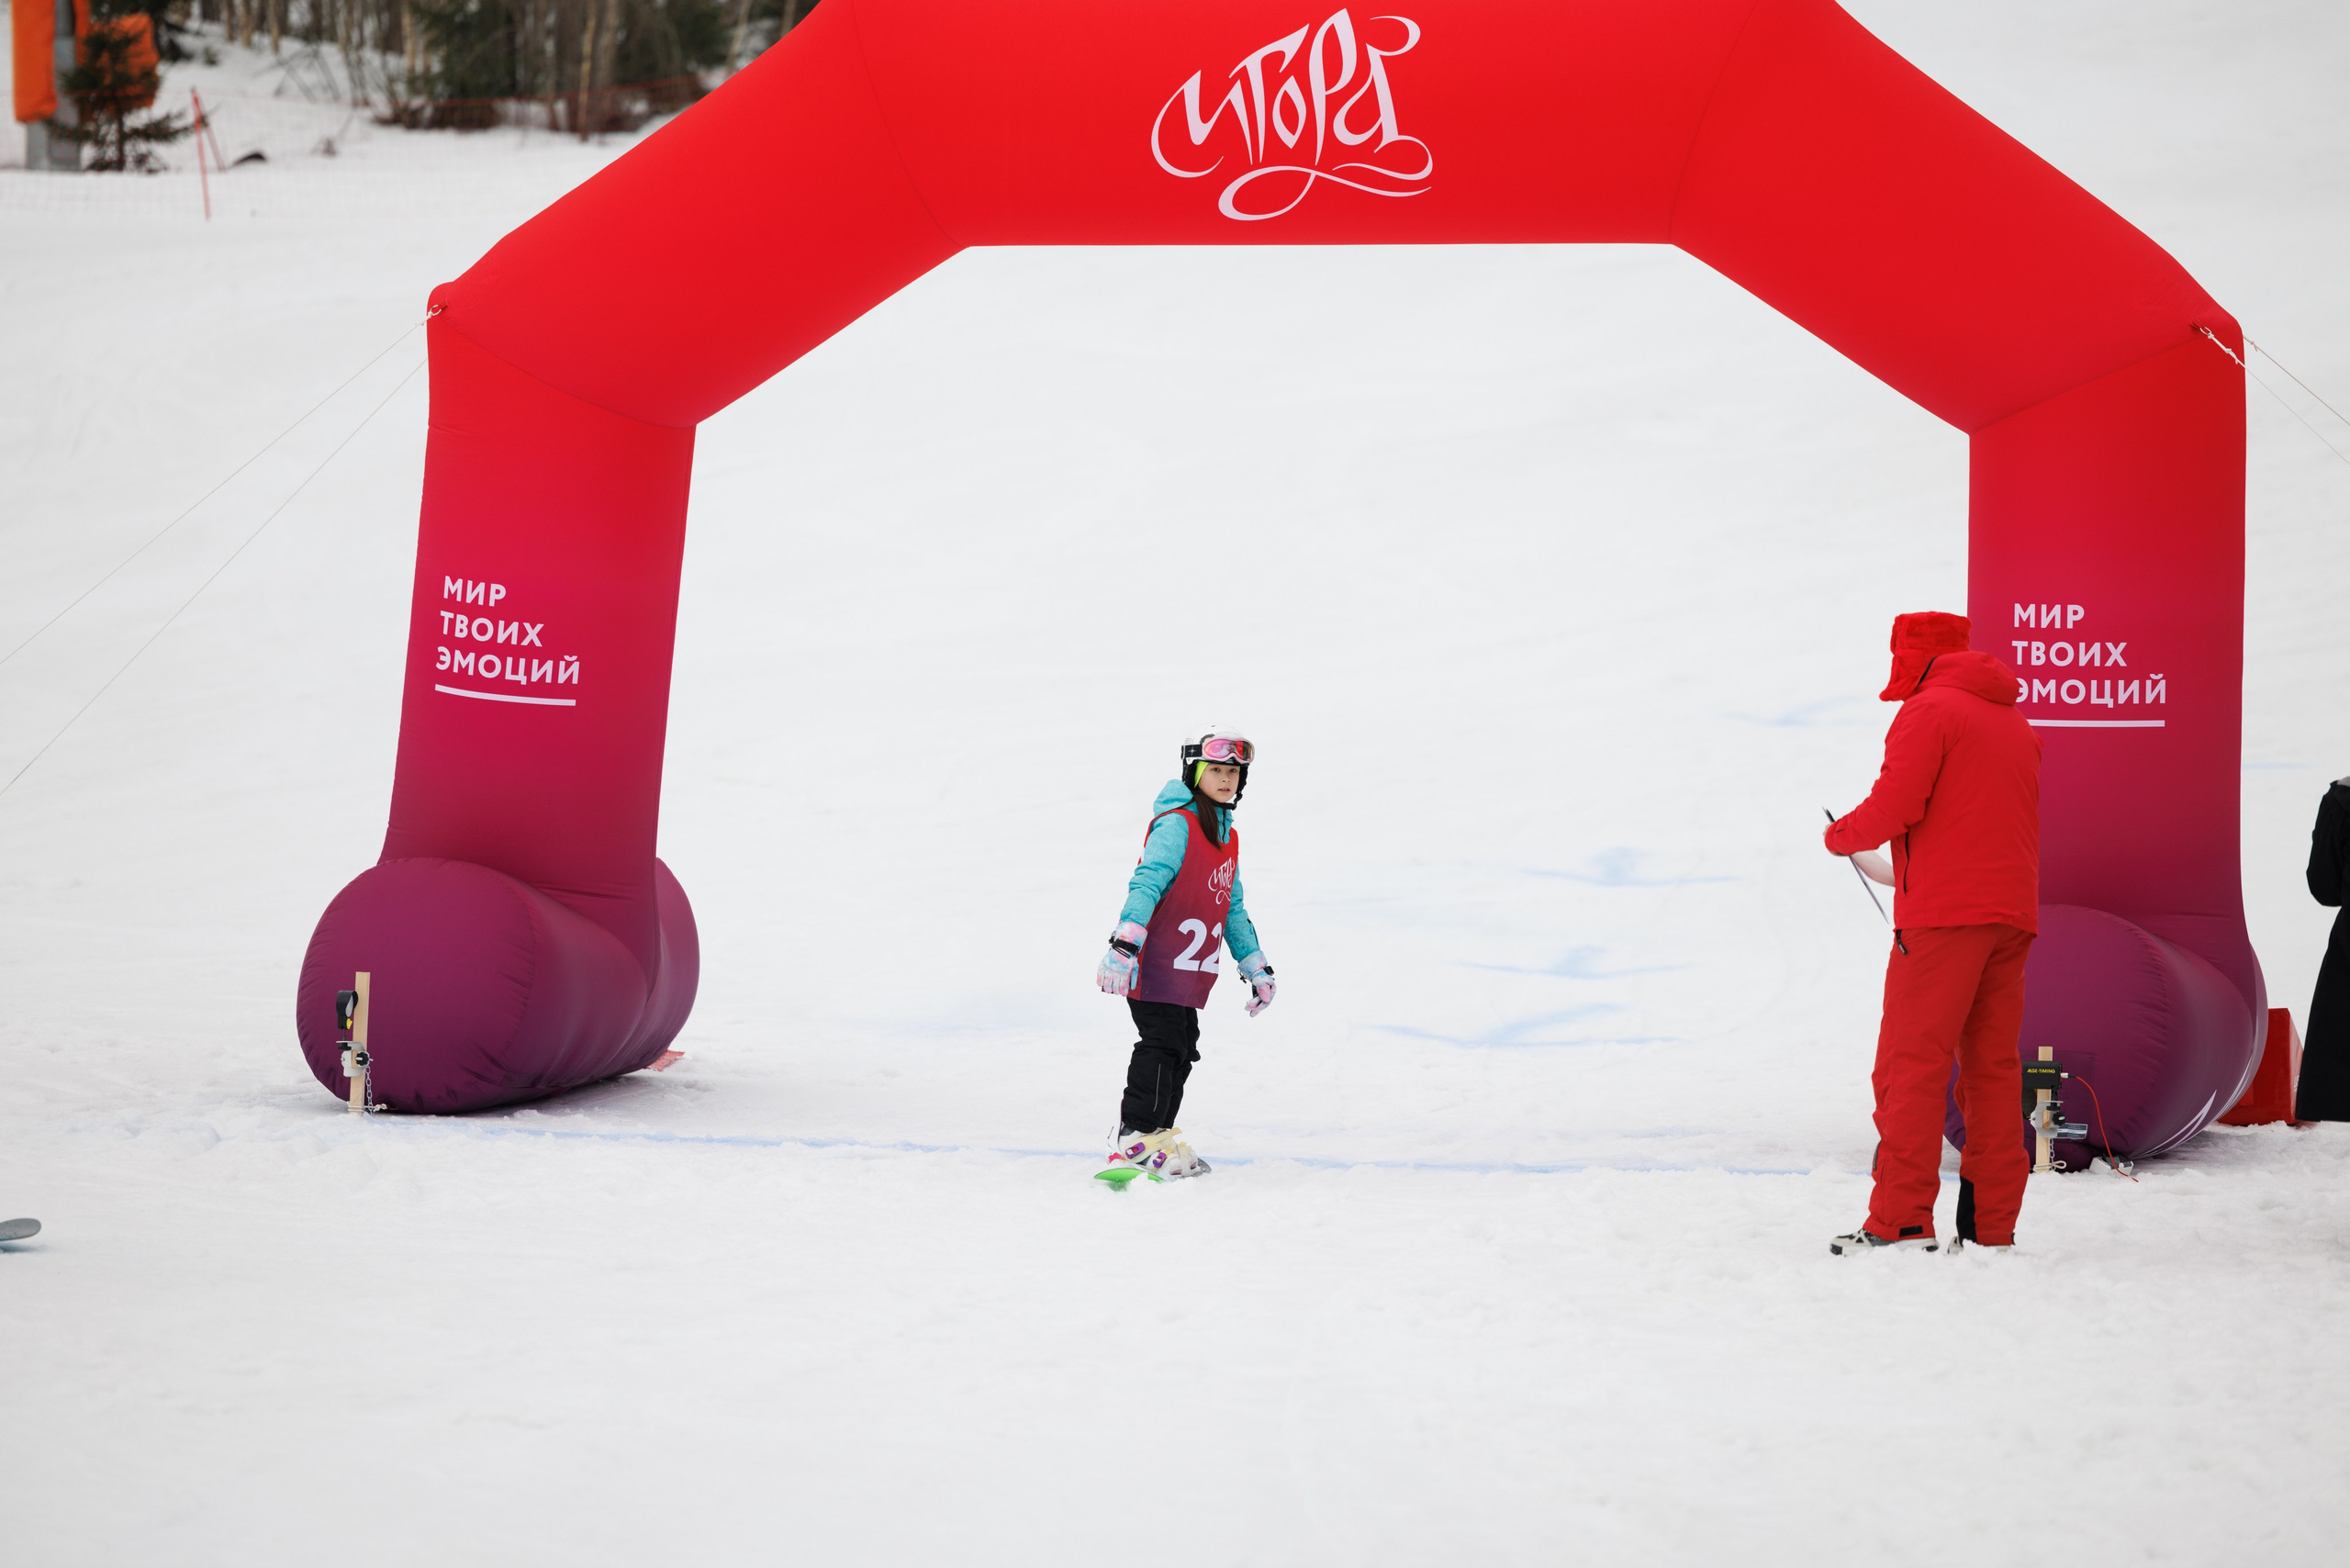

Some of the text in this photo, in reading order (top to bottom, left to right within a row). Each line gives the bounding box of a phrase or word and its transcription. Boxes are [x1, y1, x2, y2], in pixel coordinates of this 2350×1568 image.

[443, 575, 507, 607] МИР
[440, 610, 544, 647] ТВОИХ
[2013, 603, 2085, 629] МИР
[436, 645, 580, 686] ЭМОЦИЙ
[2011, 640, 2128, 666] ТВОИХ
[1173, 918, 1222, 975] 22
